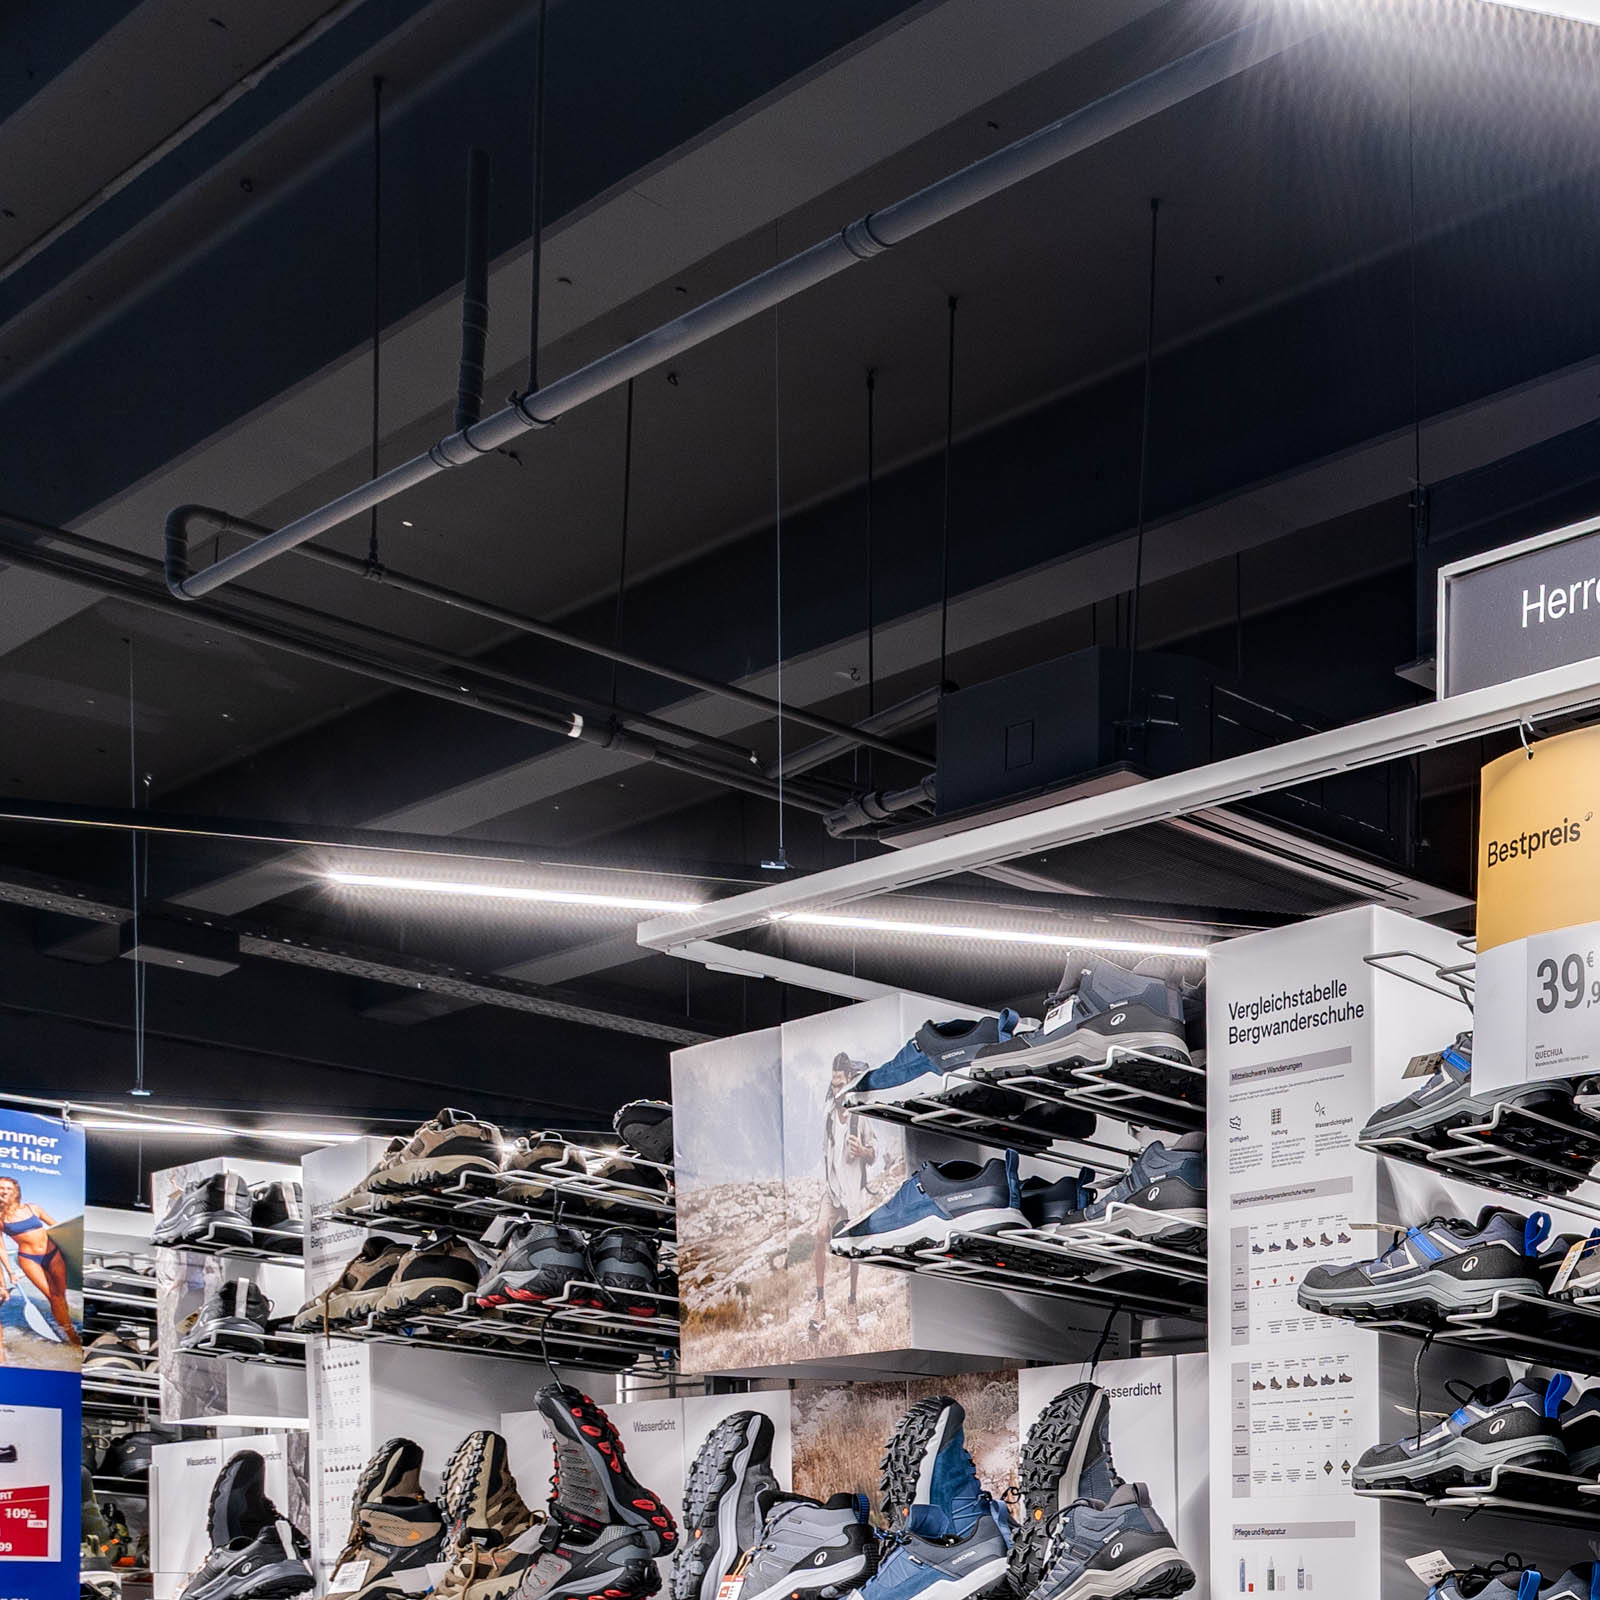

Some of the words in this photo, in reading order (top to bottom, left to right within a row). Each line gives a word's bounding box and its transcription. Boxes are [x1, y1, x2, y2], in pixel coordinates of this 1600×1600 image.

[1487, 816, 1581, 869] Bestpreis
[1536, 953, 1586, 1015] 39
[1228, 978, 1348, 1022] Vergleichstabelle
[1228, 1001, 1365, 1045] Bergwanderschuhe
[1534, 1047, 1563, 1060] QUECHUA
[1267, 1061, 1303, 1075] Wanderungen
[23, 1147, 62, 1165] hier
[1103, 1381, 1162, 1399] asserdicht
[633, 1420, 677, 1433] Wasserdicht
[1234, 1527, 1251, 1538] Pflege
[1251, 1527, 1261, 1536] und
[1262, 1526, 1286, 1538] Reparatur
